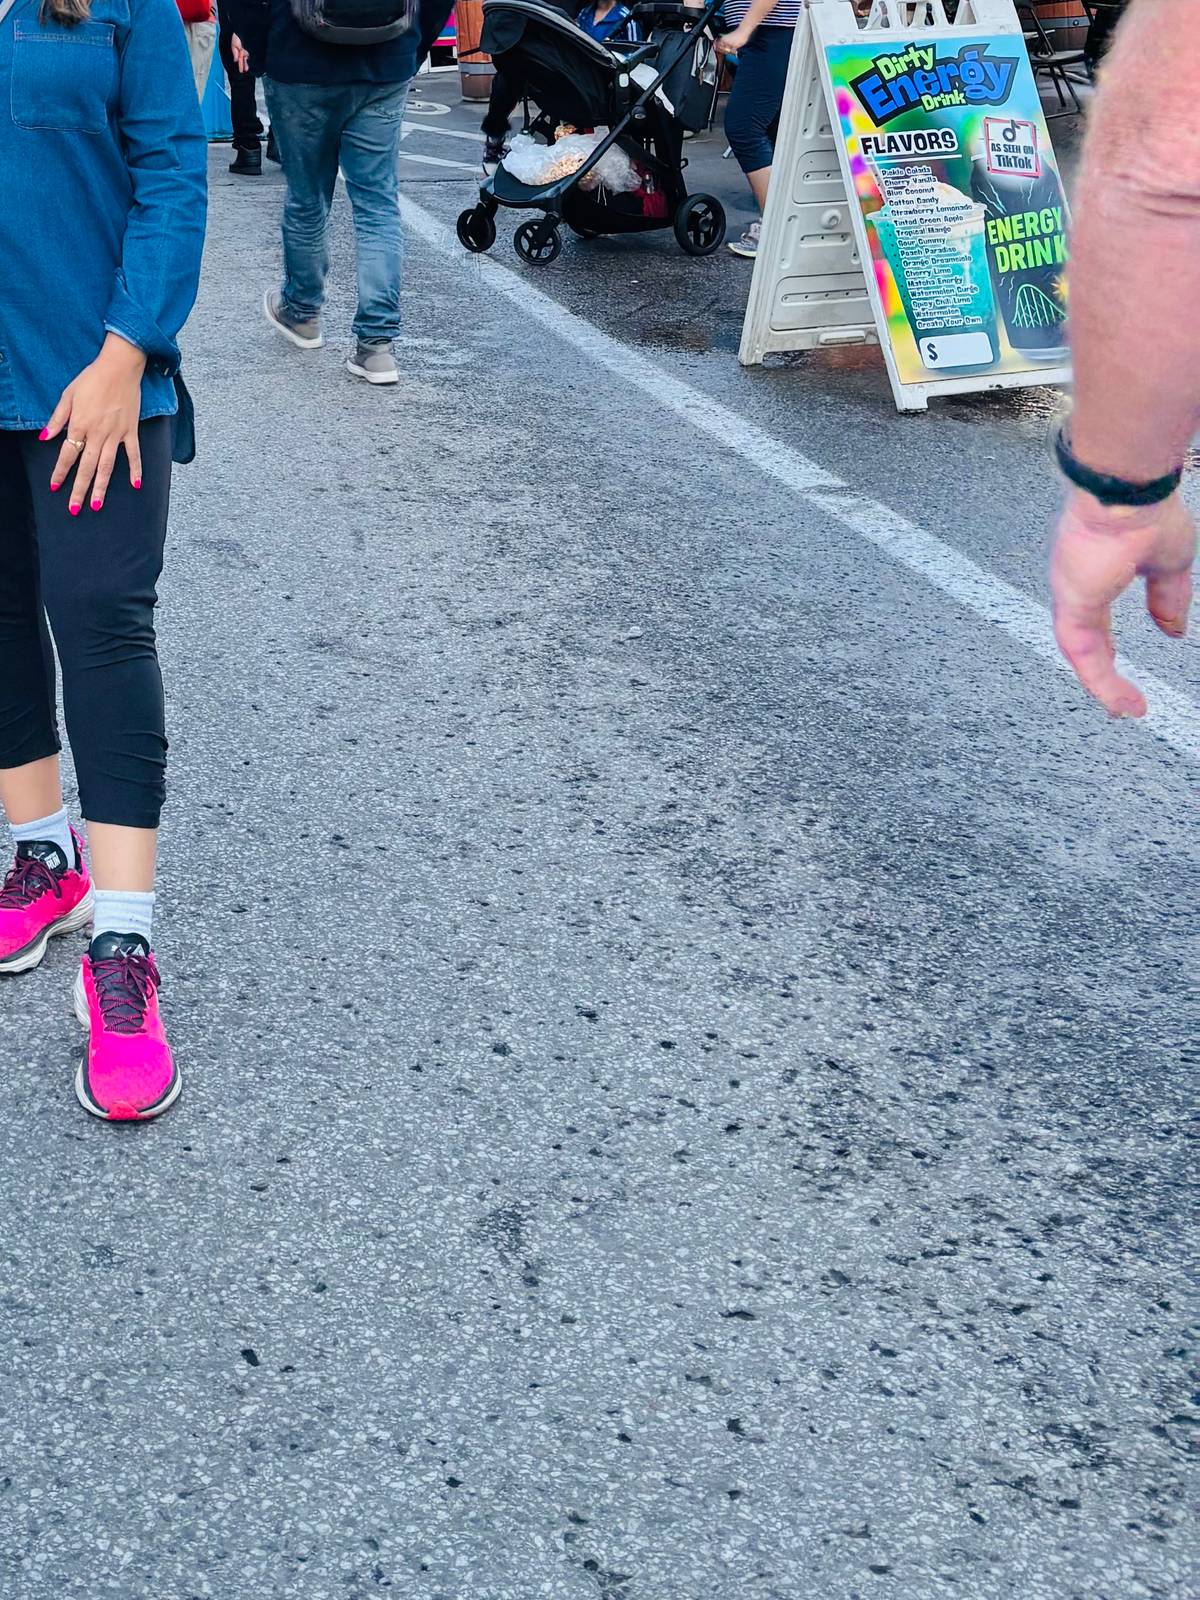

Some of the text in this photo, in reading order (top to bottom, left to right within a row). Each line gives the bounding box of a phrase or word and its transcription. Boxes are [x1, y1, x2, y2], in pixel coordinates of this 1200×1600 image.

[876, 46, 934, 81] Dirty
[857, 50, 1012, 120] Energy
[921, 90, 967, 112] Drink
[860, 130, 956, 155] FLAVORS
[991, 143, 1002, 153] AS
[1003, 143, 1021, 154] SEEN
[995, 154, 1033, 170] TikTok
[884, 179, 910, 187] Cherry
[886, 187, 935, 197] Blue Coconut
[889, 197, 939, 207] Cotton Candy
[891, 203, 972, 217] Strawberry Lemonade
[943, 215, 963, 223] Apple
[896, 225, 952, 237] Tropical Mango
[986, 207, 1063, 245] ENERGY
[901, 246, 956, 256] Peach Paradise
[995, 234, 1070, 274] DRINK
[903, 258, 929, 267] Orange
[905, 269, 931, 277] Cherry
[907, 279, 935, 287] Matcha
[910, 287, 954, 297] Watermelon
[914, 308, 959, 318] Watermelon
[917, 320, 943, 329] Create
[945, 318, 963, 326] Your
[927, 343, 938, 361] $
